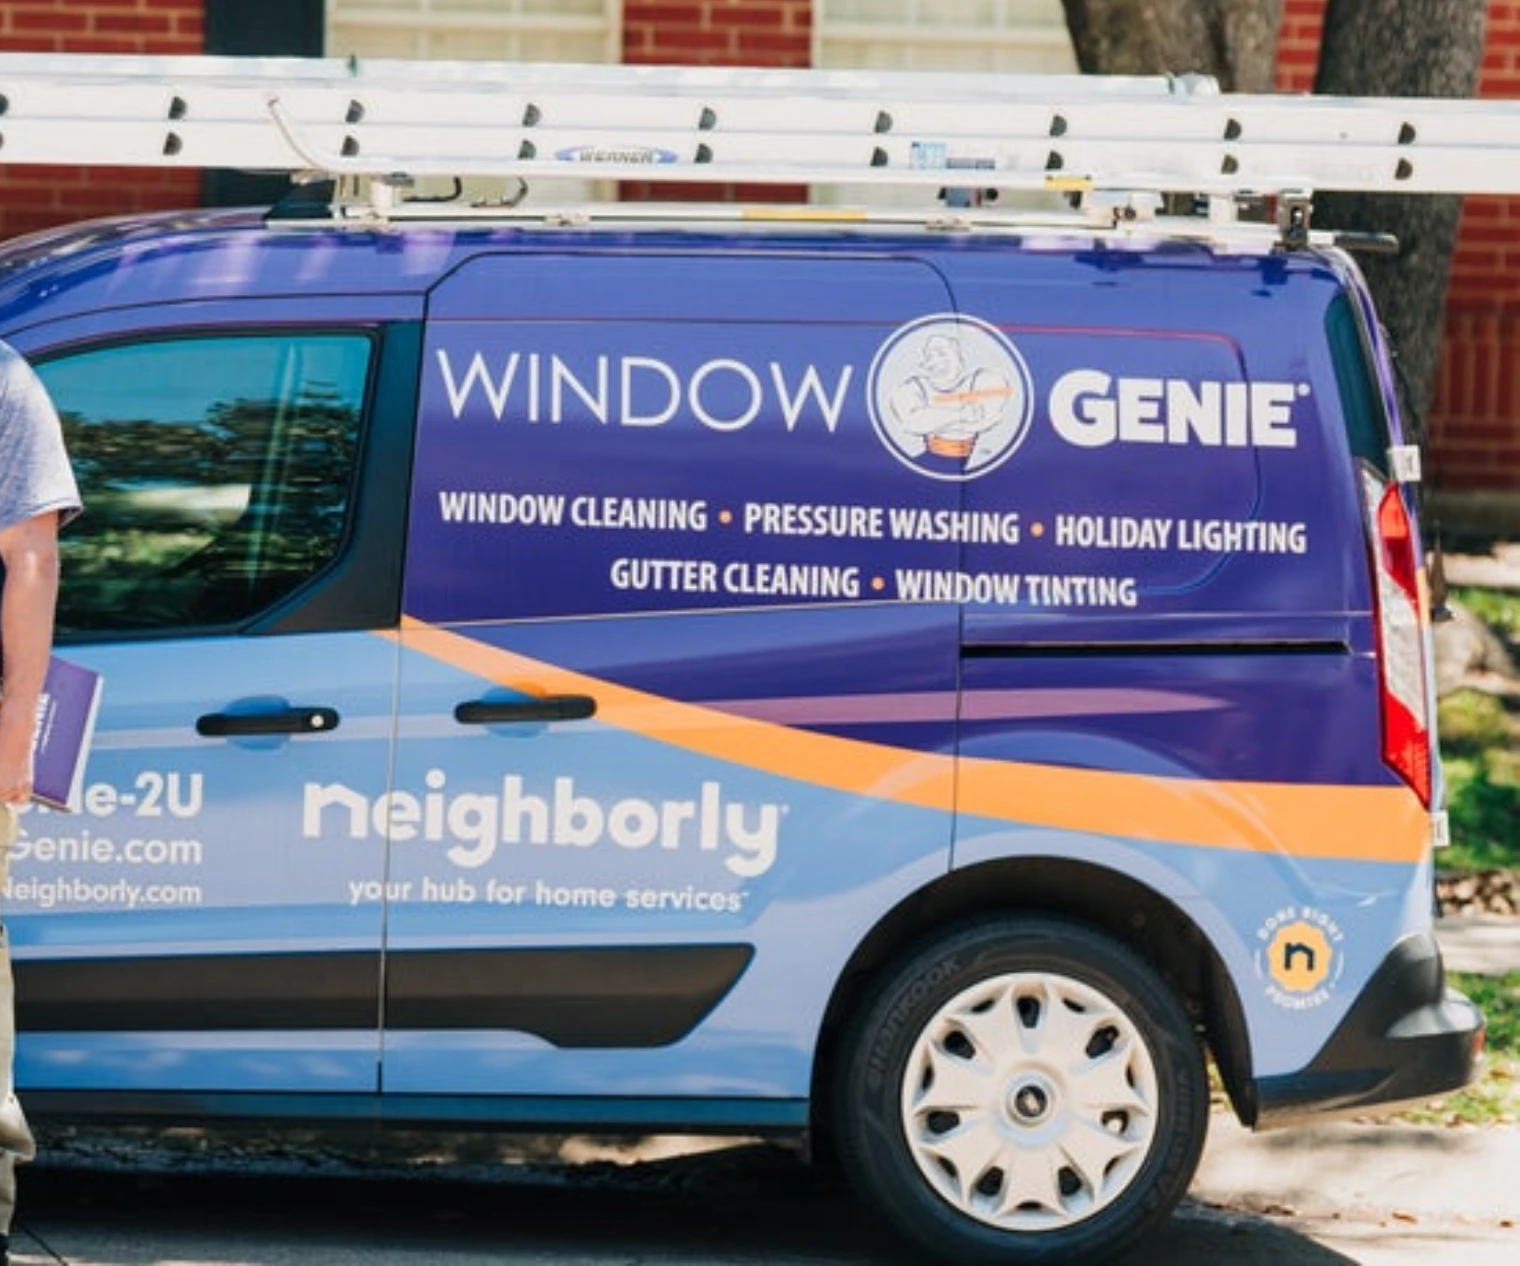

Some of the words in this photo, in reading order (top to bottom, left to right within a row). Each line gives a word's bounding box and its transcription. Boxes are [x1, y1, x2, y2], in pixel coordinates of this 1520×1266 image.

[437, 350, 853, 432] WINDOW
[1048, 369, 1298, 448] GENIE
[439, 491, 565, 525] WINDOW
[571, 497, 707, 530] CLEANING
[744, 503, 883, 537] PRESSURE
[890, 507, 1020, 544] WASHING
[1055, 515, 1172, 549] HOLIDAY
[1178, 519, 1307, 553] LIGHTING
[611, 558, 717, 592] GUTTER
[723, 563, 859, 598] CLEANING
[896, 569, 1019, 603] WINDOW
[1025, 574, 1137, 606] TINTING
[302, 768, 779, 877] neighborly
[348, 878, 412, 905] your
[422, 876, 476, 903] hub
[486, 879, 525, 904] for
[536, 881, 616, 907] home
[626, 888, 742, 913] services
